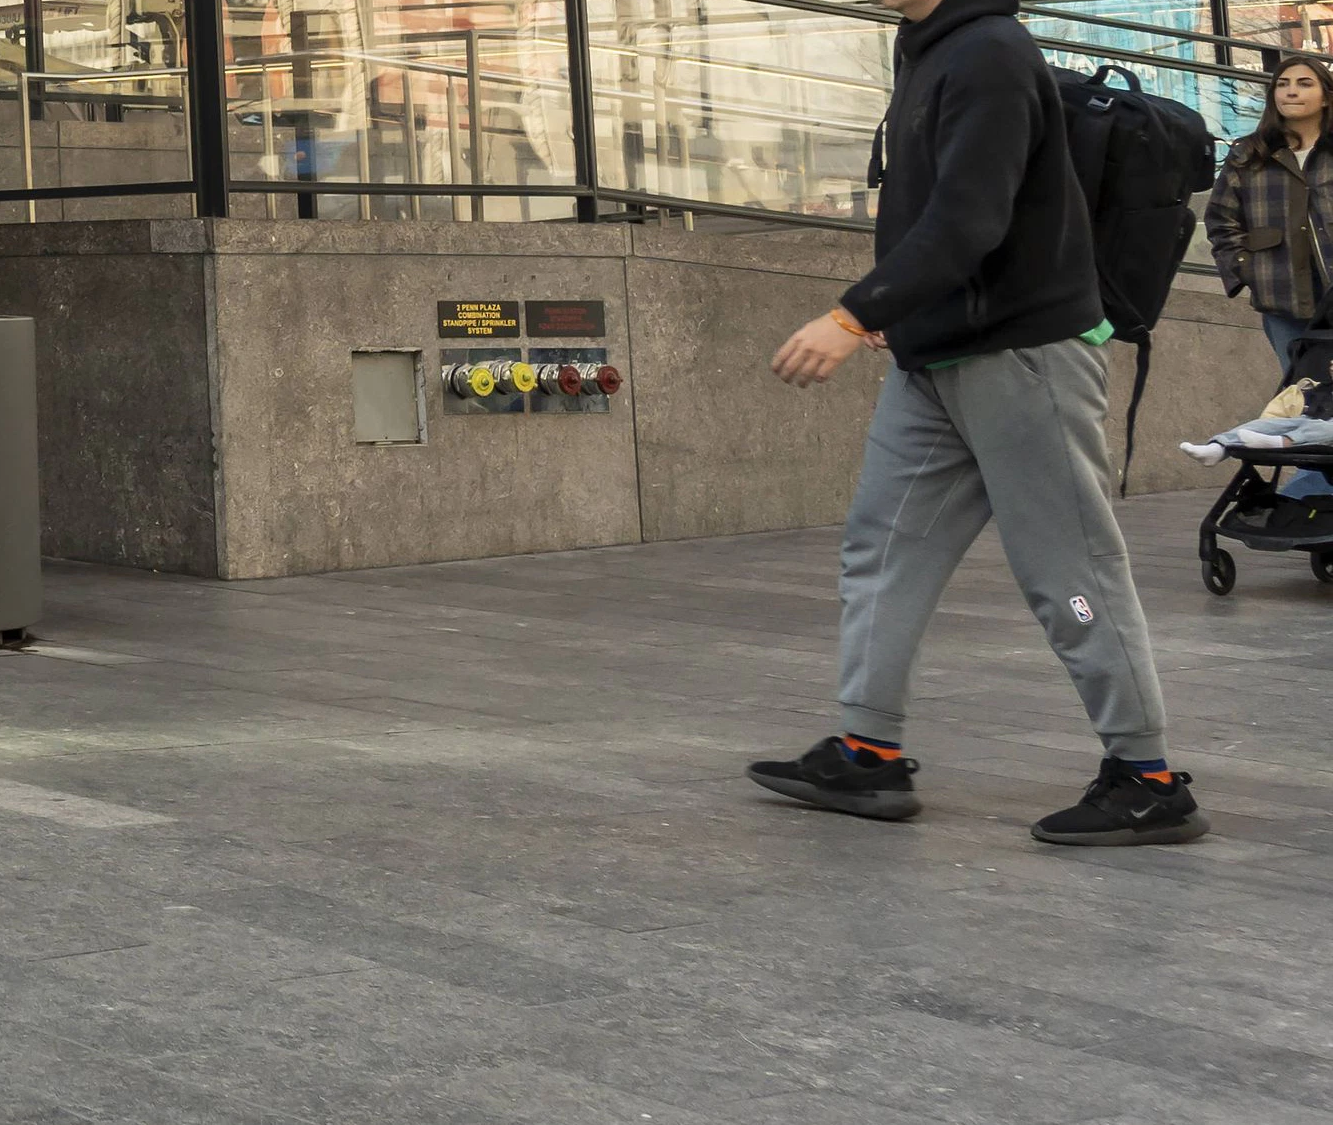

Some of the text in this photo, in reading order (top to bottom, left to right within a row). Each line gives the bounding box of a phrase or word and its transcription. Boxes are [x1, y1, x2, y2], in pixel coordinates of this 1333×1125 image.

[461, 303, 479, 312] PENN
[479, 303, 502, 312] PLAZA
[457, 311, 501, 319] COMBINATION
[443, 319, 477, 327] STANDPIPE
[481, 319, 517, 327] SPRINKLER
[467, 326, 493, 335] SYSTEM
